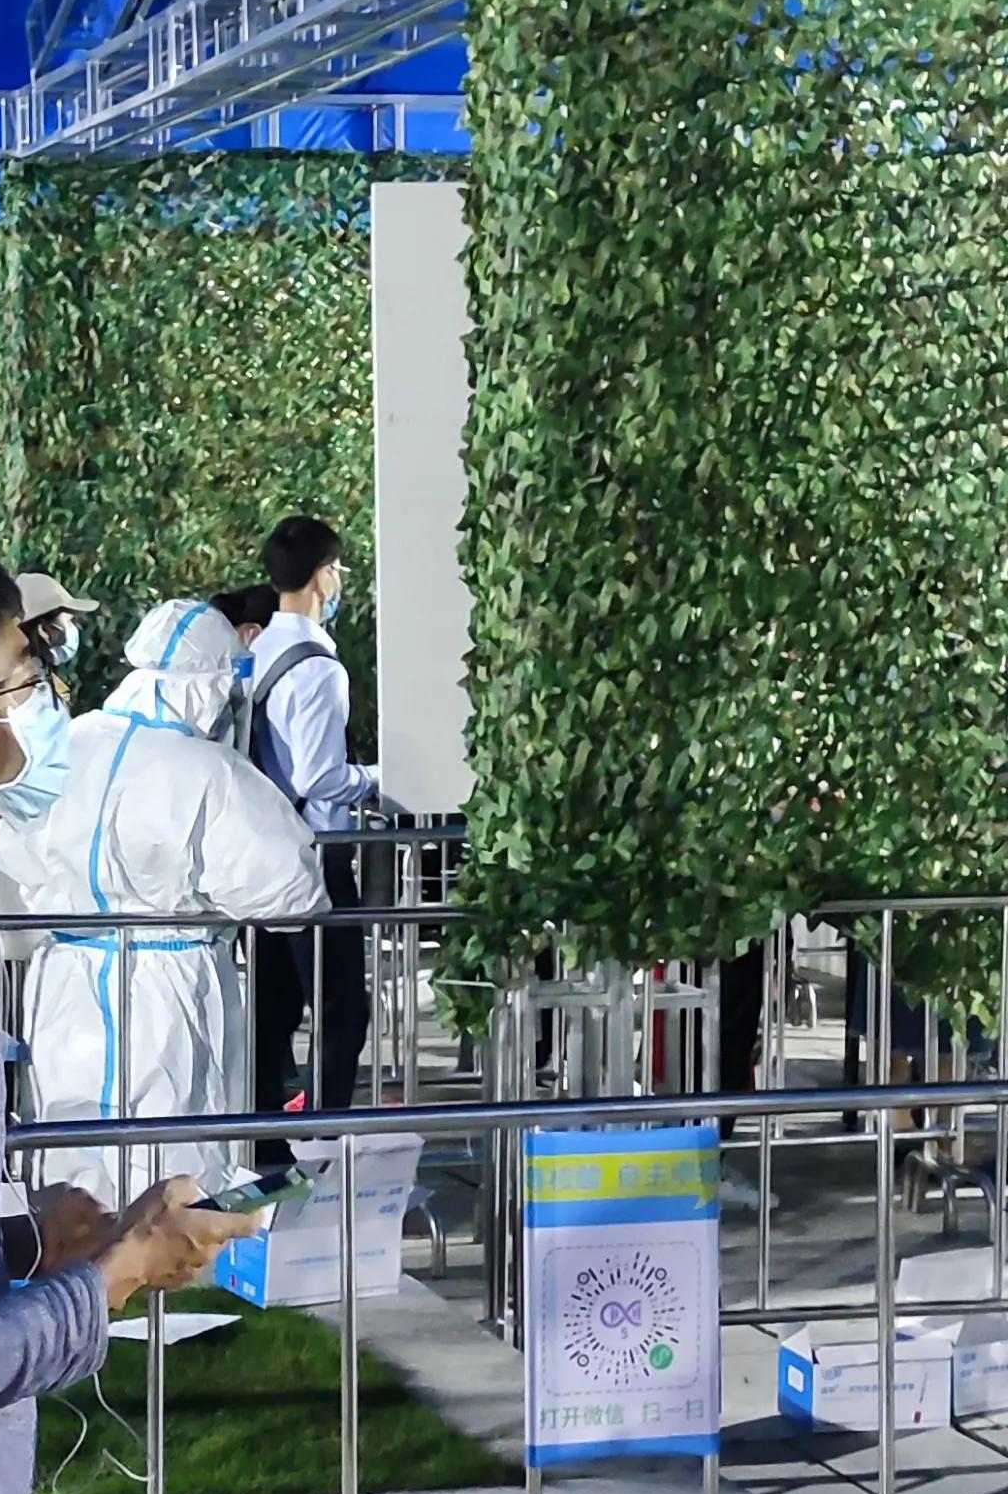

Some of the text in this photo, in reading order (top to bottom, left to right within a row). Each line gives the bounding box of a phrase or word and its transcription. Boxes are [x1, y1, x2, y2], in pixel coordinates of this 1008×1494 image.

[540, 1399, 704, 1429] 打开微信 扫一扫
